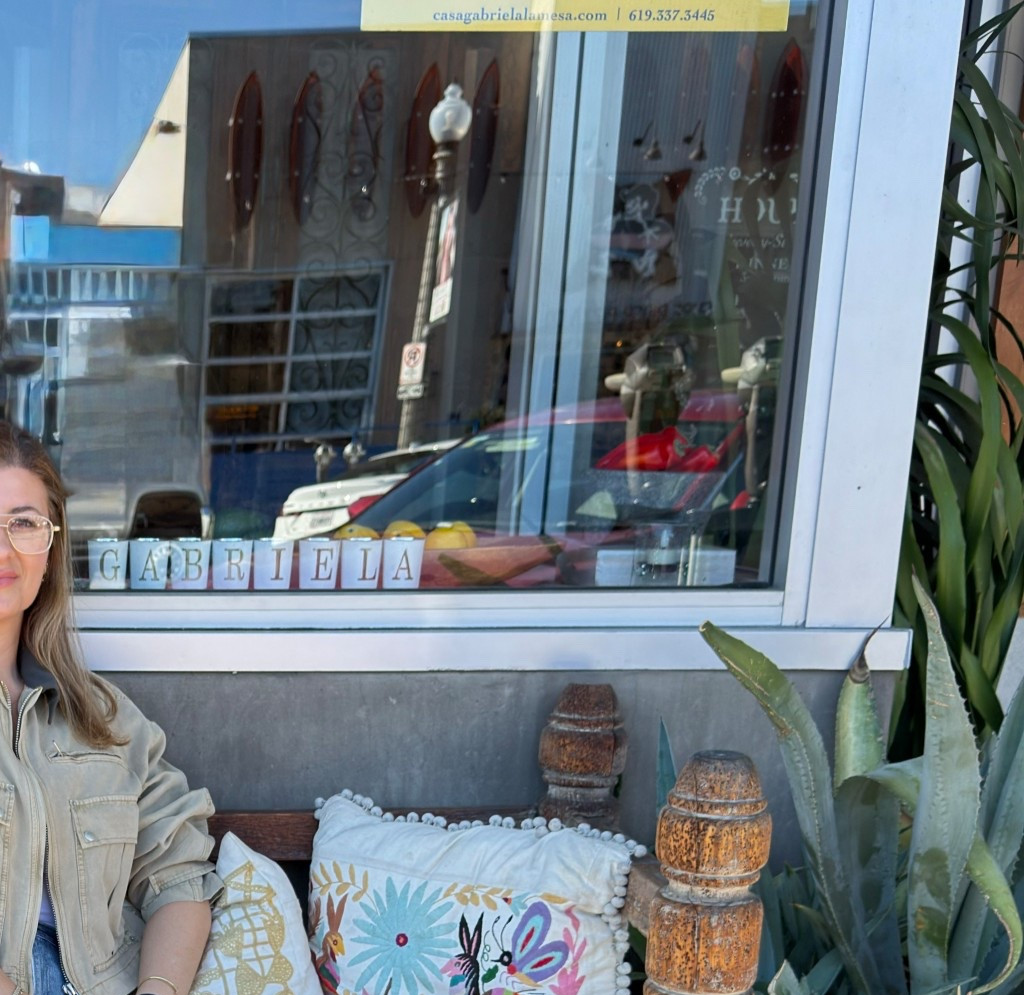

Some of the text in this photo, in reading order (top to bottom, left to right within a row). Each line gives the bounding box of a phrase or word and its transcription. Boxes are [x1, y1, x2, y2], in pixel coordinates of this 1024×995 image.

[432, 7, 608, 25] casagabrielalamesa.com
[628, 8, 716, 22] 619.337.3445
[98, 547, 414, 582] GABRIELA
